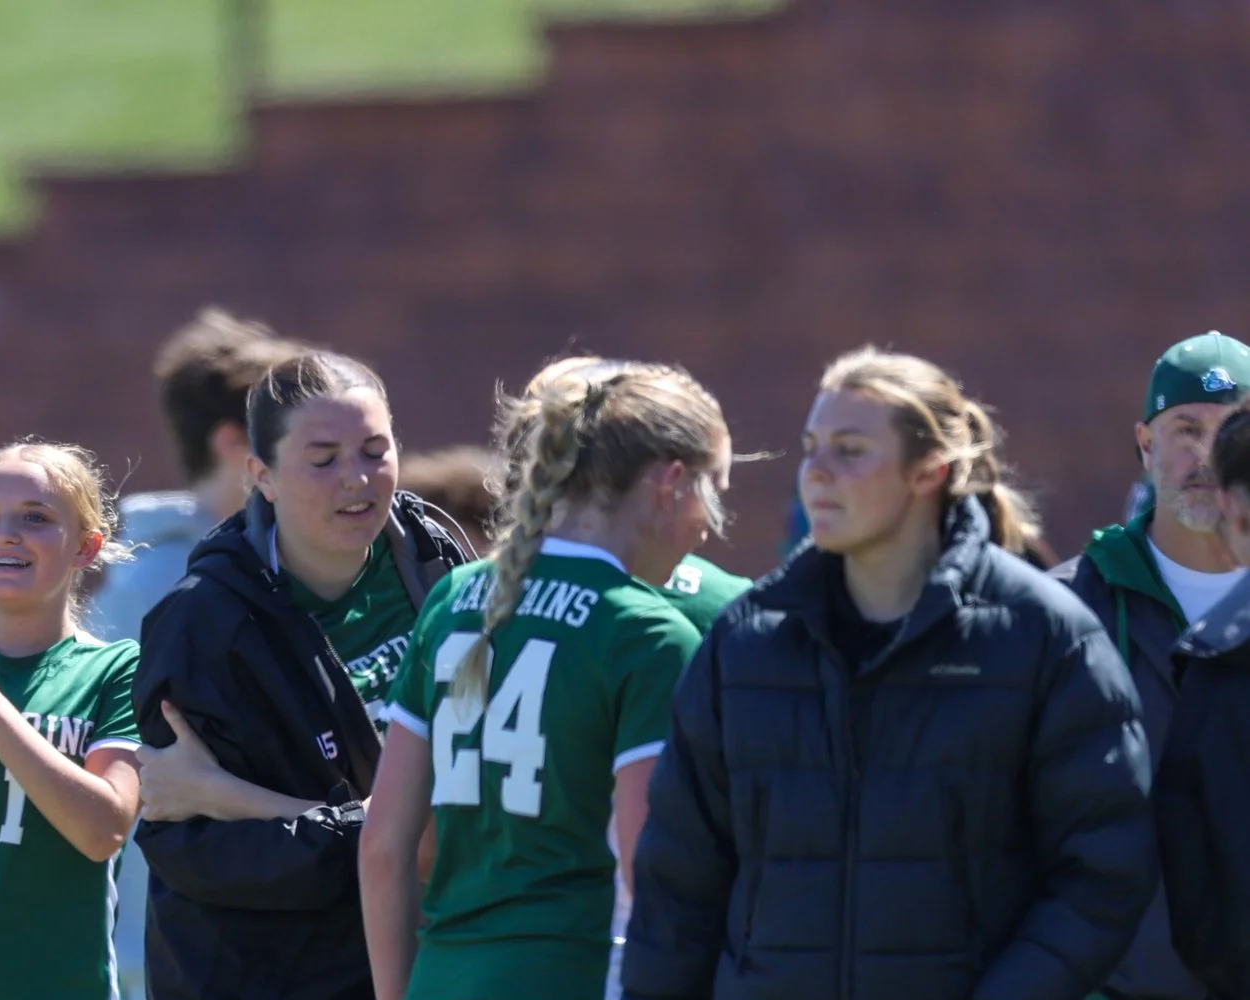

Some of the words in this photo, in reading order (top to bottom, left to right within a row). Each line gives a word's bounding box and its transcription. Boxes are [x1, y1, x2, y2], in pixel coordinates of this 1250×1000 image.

[451, 572, 600, 629] CAAINS
[316, 729, 338, 760] 15
[430, 631, 558, 819] 24
